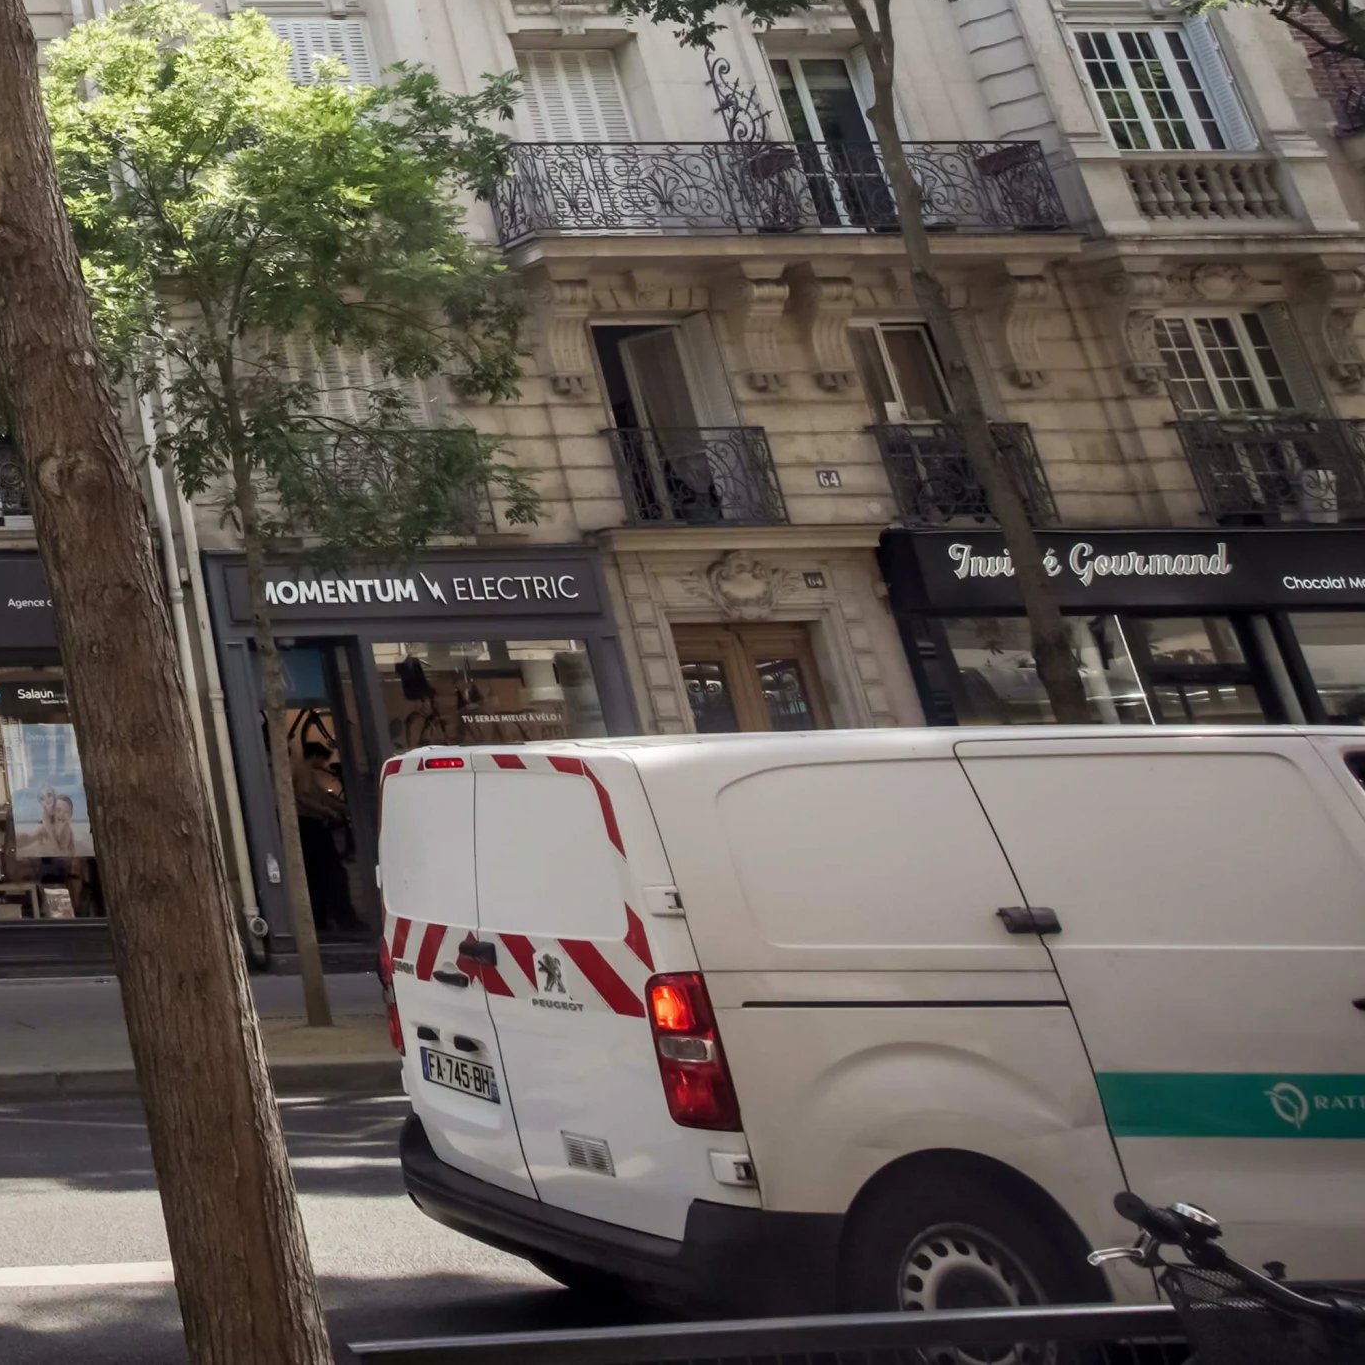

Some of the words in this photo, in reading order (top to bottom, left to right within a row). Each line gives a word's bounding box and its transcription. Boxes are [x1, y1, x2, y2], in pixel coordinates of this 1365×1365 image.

[819, 472, 839, 487] 64
[948, 543, 1062, 579] Invié
[1069, 542, 1232, 586] Gourmand
[453, 576, 579, 601] ELECTRIC
[1283, 575, 1346, 590] Chocolat
[7, 598, 45, 609] Agence
[461, 715, 474, 723] TU
[475, 715, 500, 723] SERAS
[501, 714, 527, 723] MIEUX
[532, 998, 584, 1012] PEUGEOT
